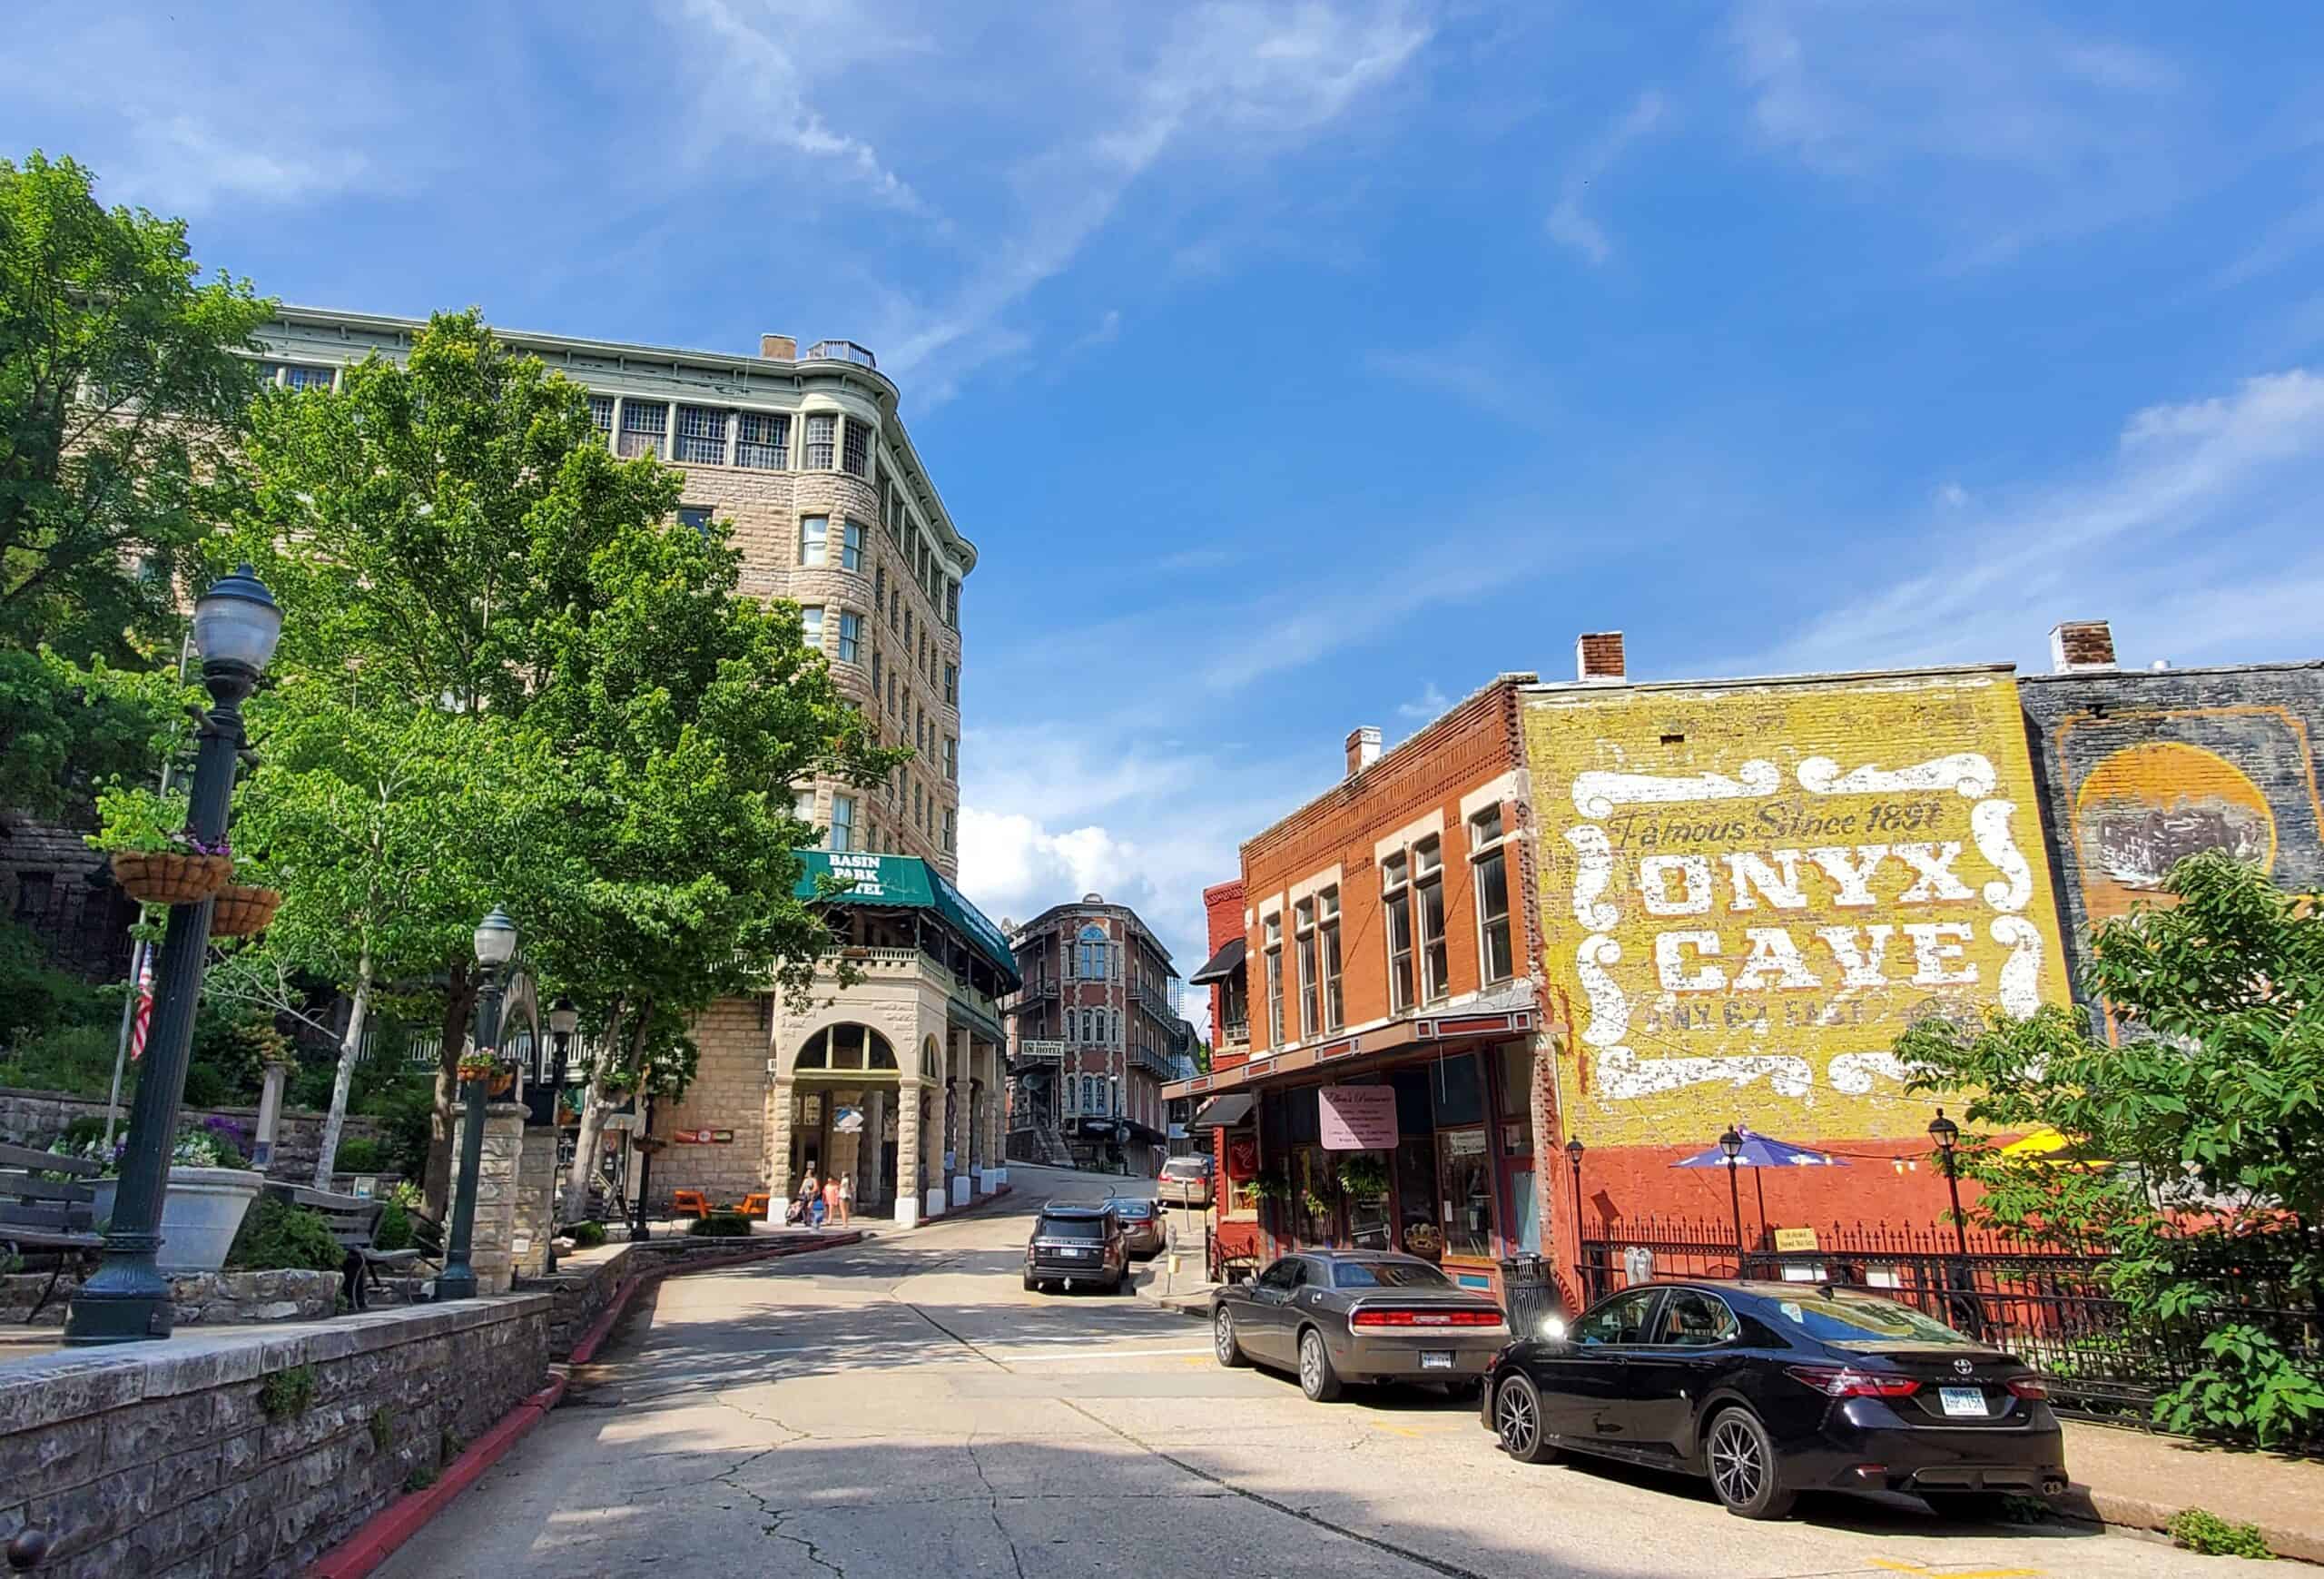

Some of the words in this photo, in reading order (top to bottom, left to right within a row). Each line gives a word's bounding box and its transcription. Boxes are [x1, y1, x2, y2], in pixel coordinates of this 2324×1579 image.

[1607, 811, 1746, 848] Famous
[1752, 800, 1856, 840] Since
[829, 854, 880, 869] BASIN
[833, 867, 880, 882] PARK
[842, 882, 885, 895] TEL
[1637, 841, 1975, 916] ONYX
[1652, 922, 1980, 993] CAVE
